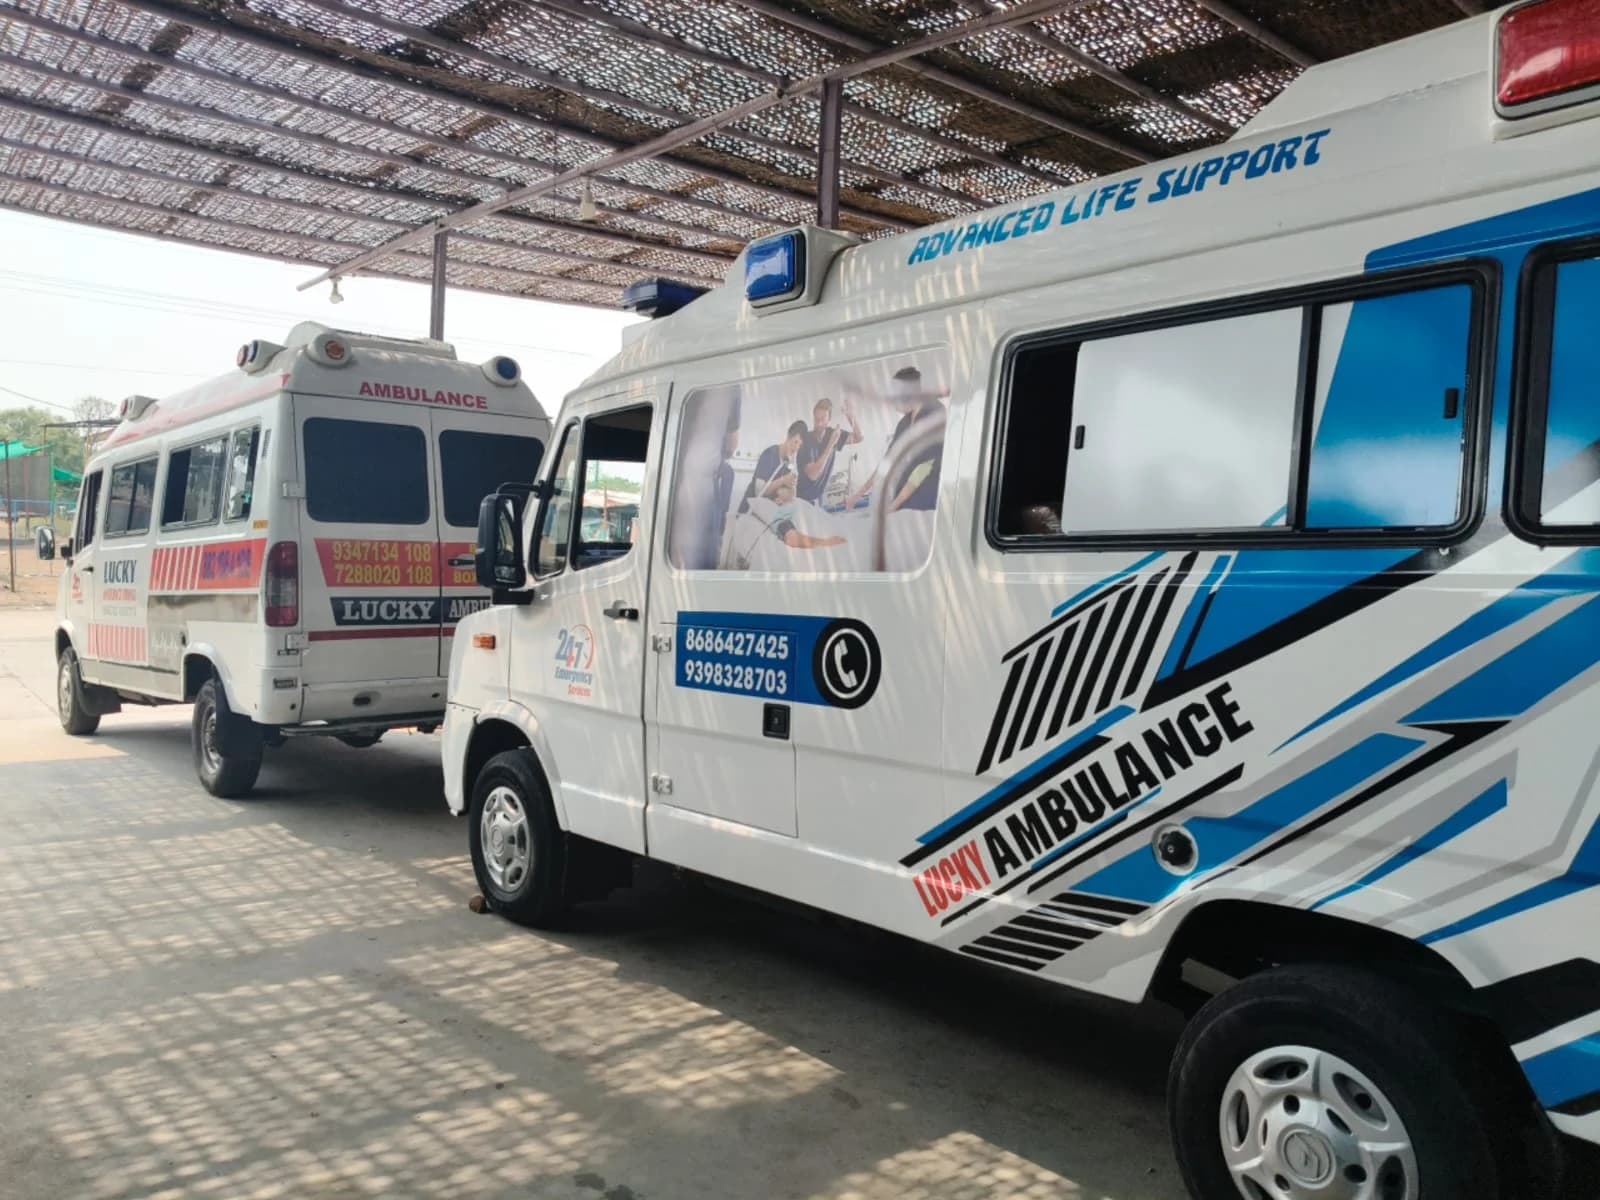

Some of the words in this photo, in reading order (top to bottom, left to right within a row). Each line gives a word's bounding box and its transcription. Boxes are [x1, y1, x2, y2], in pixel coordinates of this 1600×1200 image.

[907, 202, 1056, 266] ADVANCED
[1060, 177, 1142, 226] LIFE
[1147, 128, 1331, 203] SUPPORT
[359, 381, 488, 410] AMBULANCE
[333, 541, 399, 561] 9347134
[405, 543, 431, 562] 108
[103, 559, 137, 584] LUCKY
[335, 564, 400, 585] 7288020
[407, 566, 433, 585] 108
[342, 600, 435, 620] LUCKY
[685, 628, 789, 660] 8686427425
[684, 659, 788, 695] 9398328703
[913, 840, 993, 918] LUCKY
[983, 681, 1254, 878] AMBULANCE
